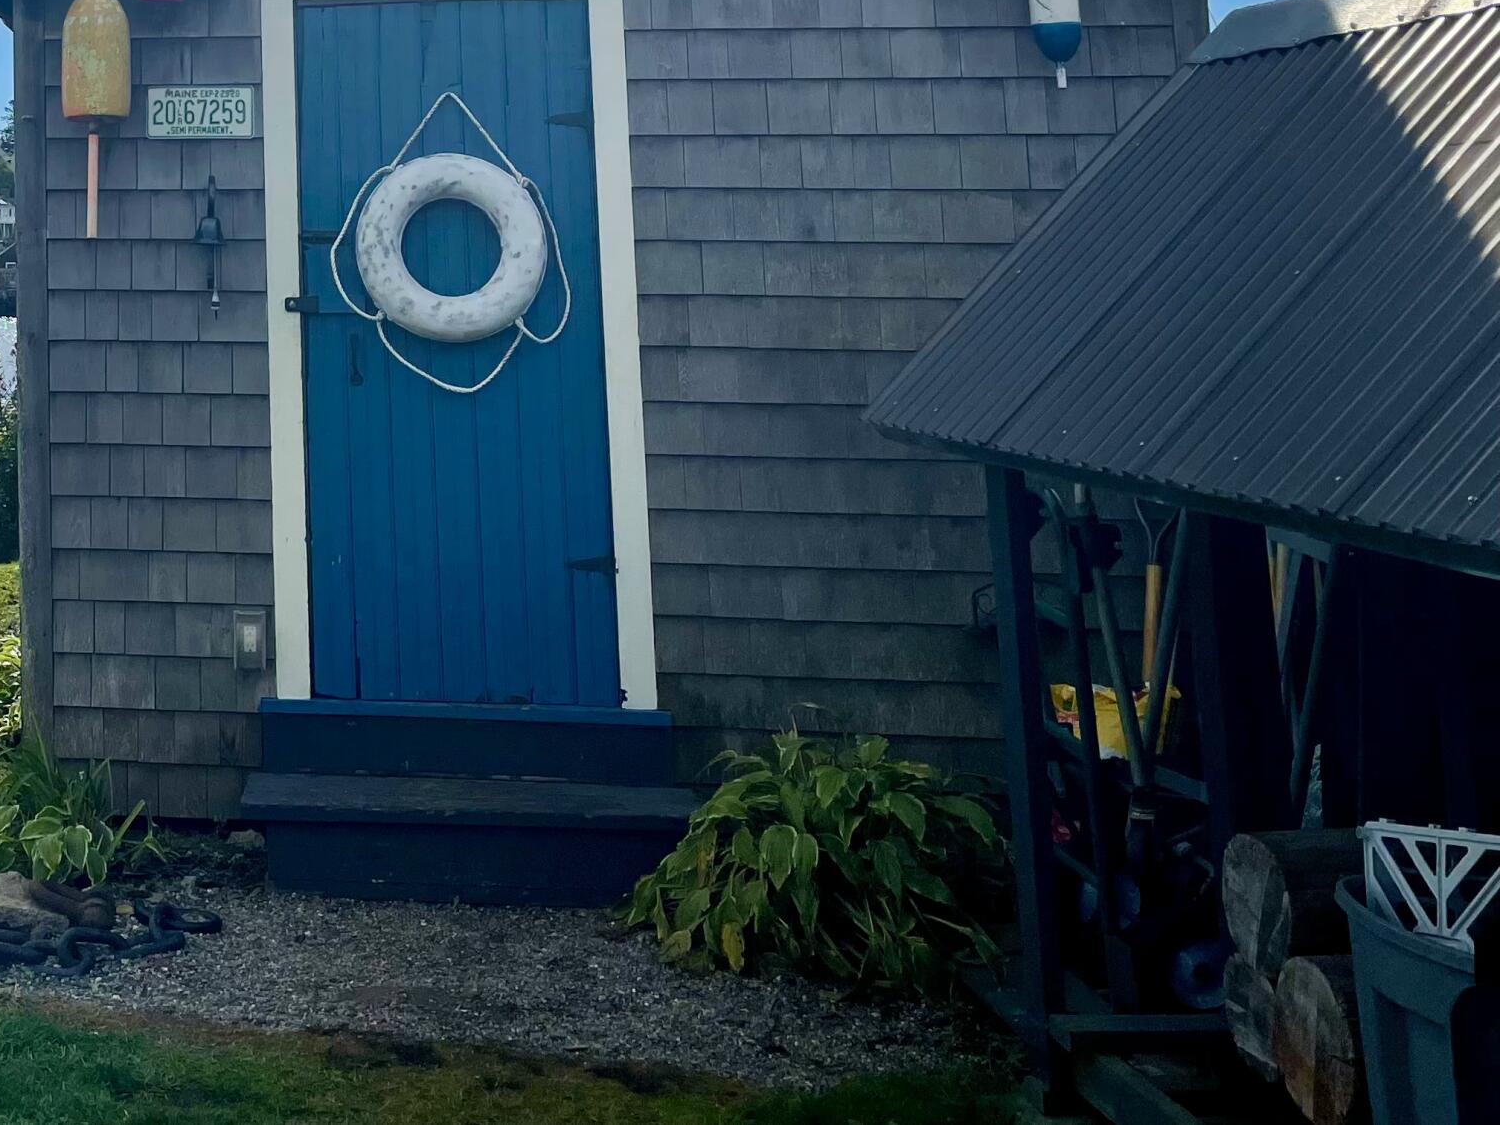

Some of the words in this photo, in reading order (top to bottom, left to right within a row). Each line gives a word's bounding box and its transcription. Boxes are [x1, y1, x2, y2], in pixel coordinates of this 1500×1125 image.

[165, 89, 198, 98] MAINE
[171, 126, 187, 134] SEMI
[188, 126, 229, 134] PERMANENT
